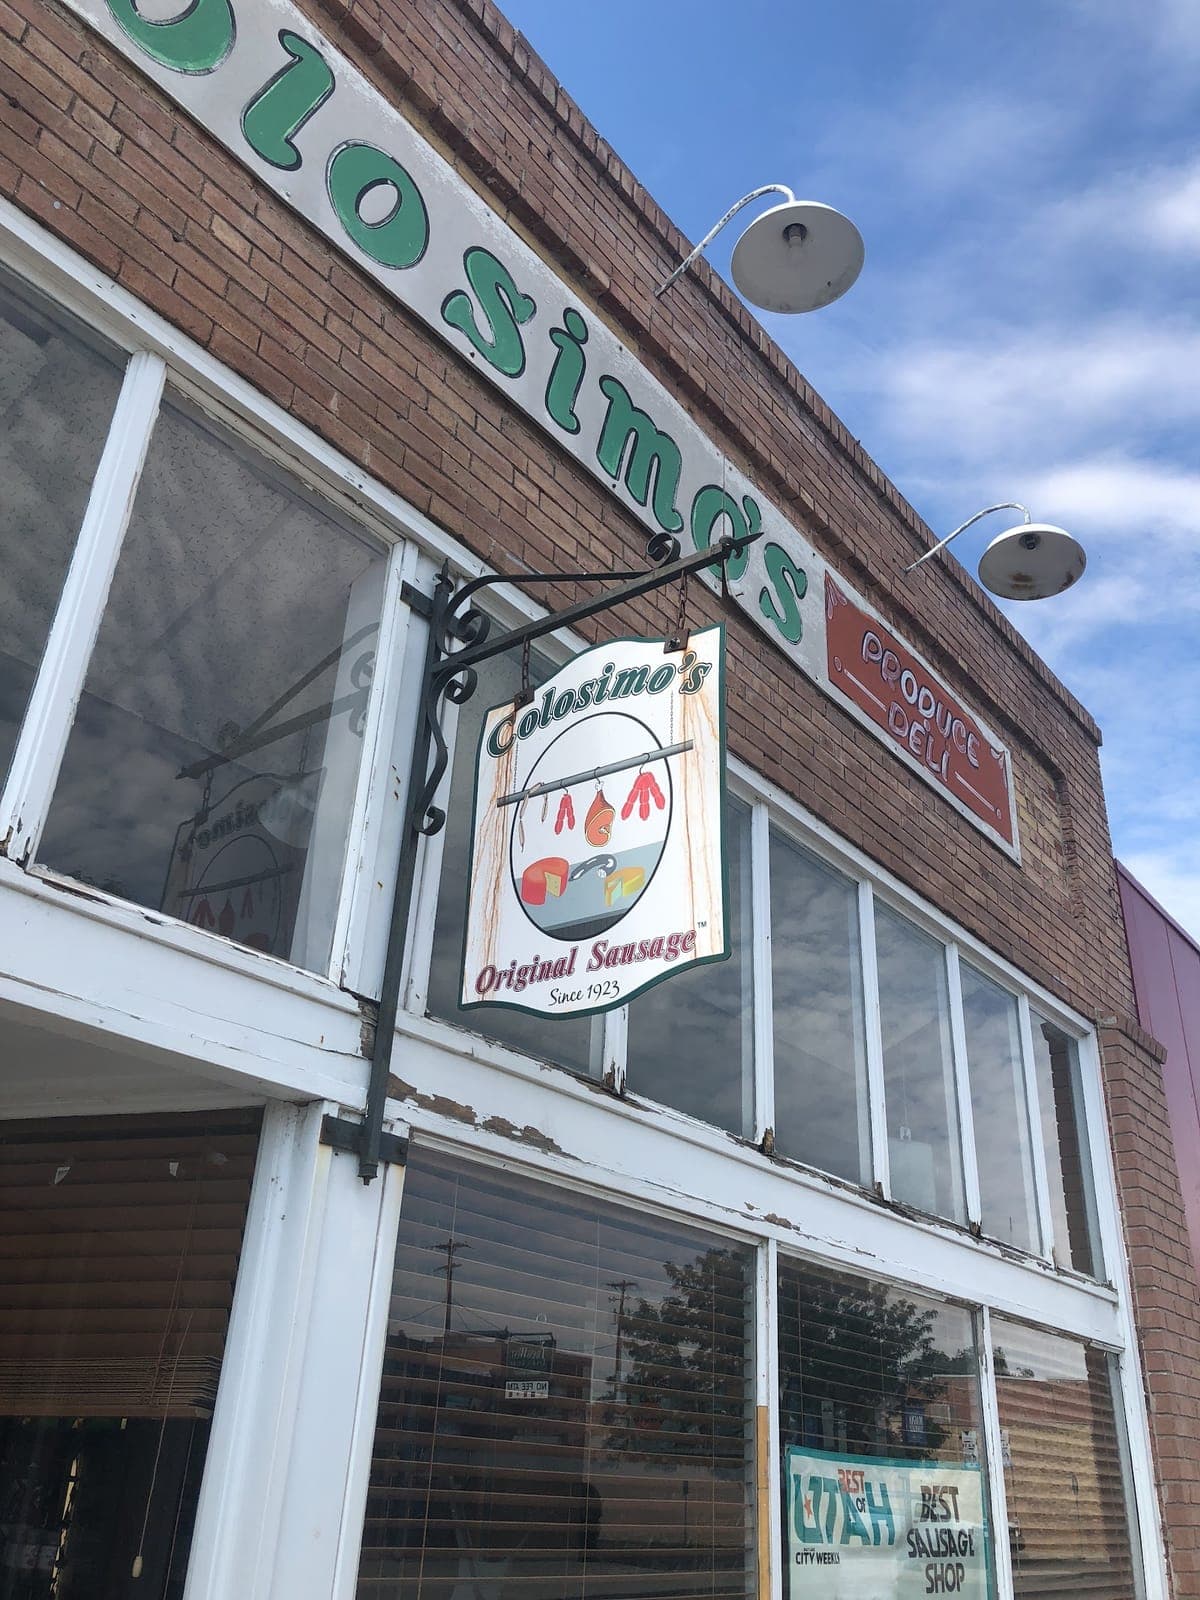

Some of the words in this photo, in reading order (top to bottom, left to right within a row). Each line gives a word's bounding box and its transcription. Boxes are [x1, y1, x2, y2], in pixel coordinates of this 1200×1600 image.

[487, 650, 712, 758] Colosimo's
[861, 631, 981, 769] PRODUCE
[888, 702, 949, 782] DELI
[474, 945, 579, 995] Original
[586, 929, 697, 972] Sausage
[548, 987, 584, 1006] Since
[586, 980, 620, 999] 1923
[838, 1469, 864, 1493] BEST
[920, 1485, 960, 1523] BEST
[793, 1474, 896, 1546] UTAH
[795, 1551, 816, 1565] CITY
[925, 1562, 966, 1594] SHOP
